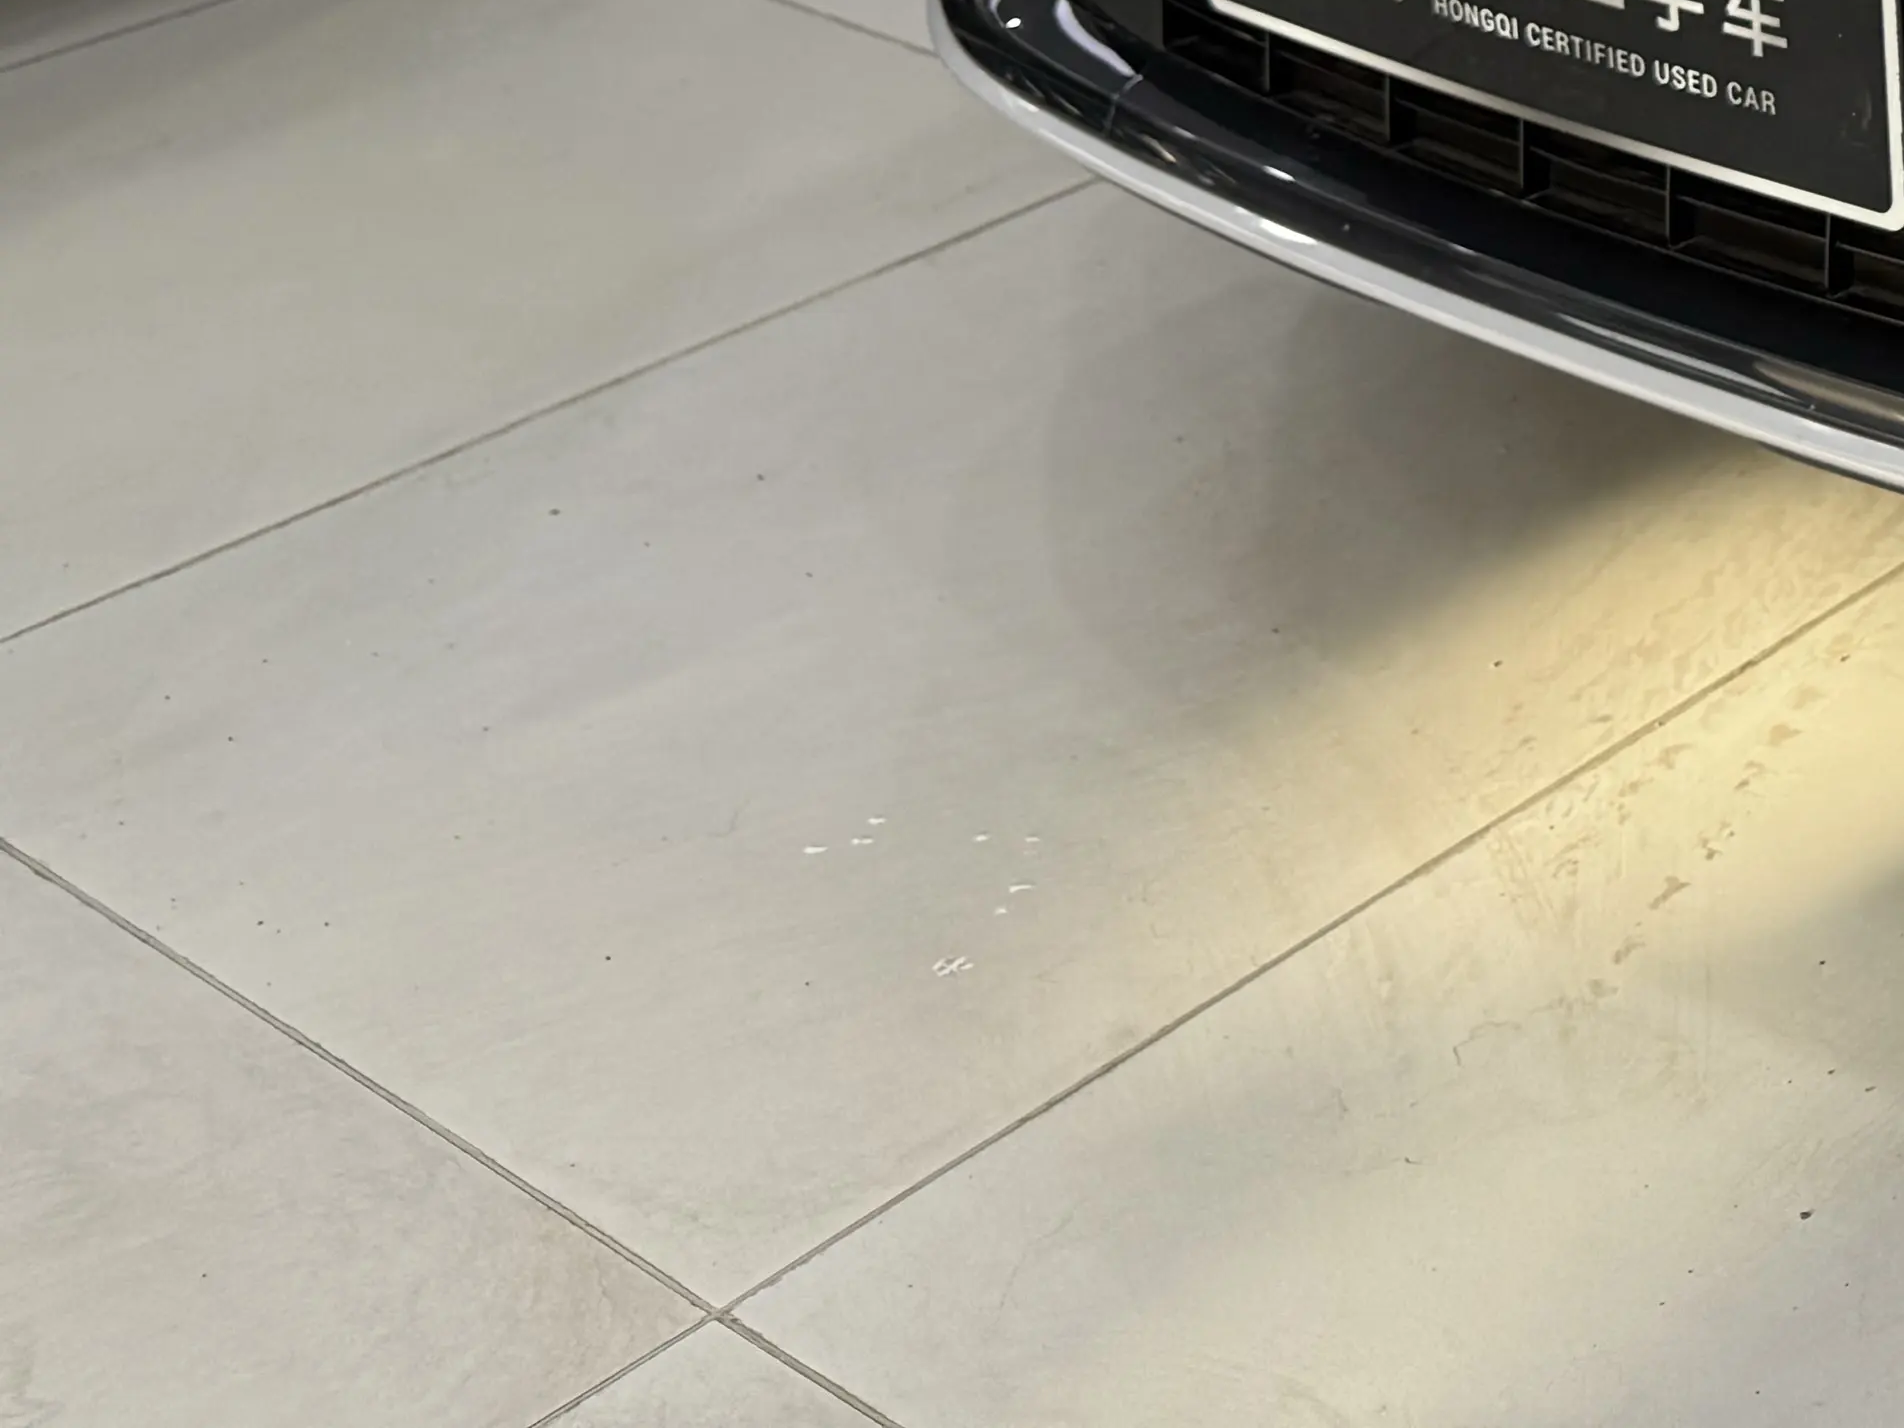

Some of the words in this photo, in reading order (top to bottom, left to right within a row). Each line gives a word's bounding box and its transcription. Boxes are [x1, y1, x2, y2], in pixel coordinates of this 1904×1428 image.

[1526, 21, 1646, 78] CERTIFIED
[1652, 60, 1718, 99] USED
[1726, 81, 1777, 116] CAR
